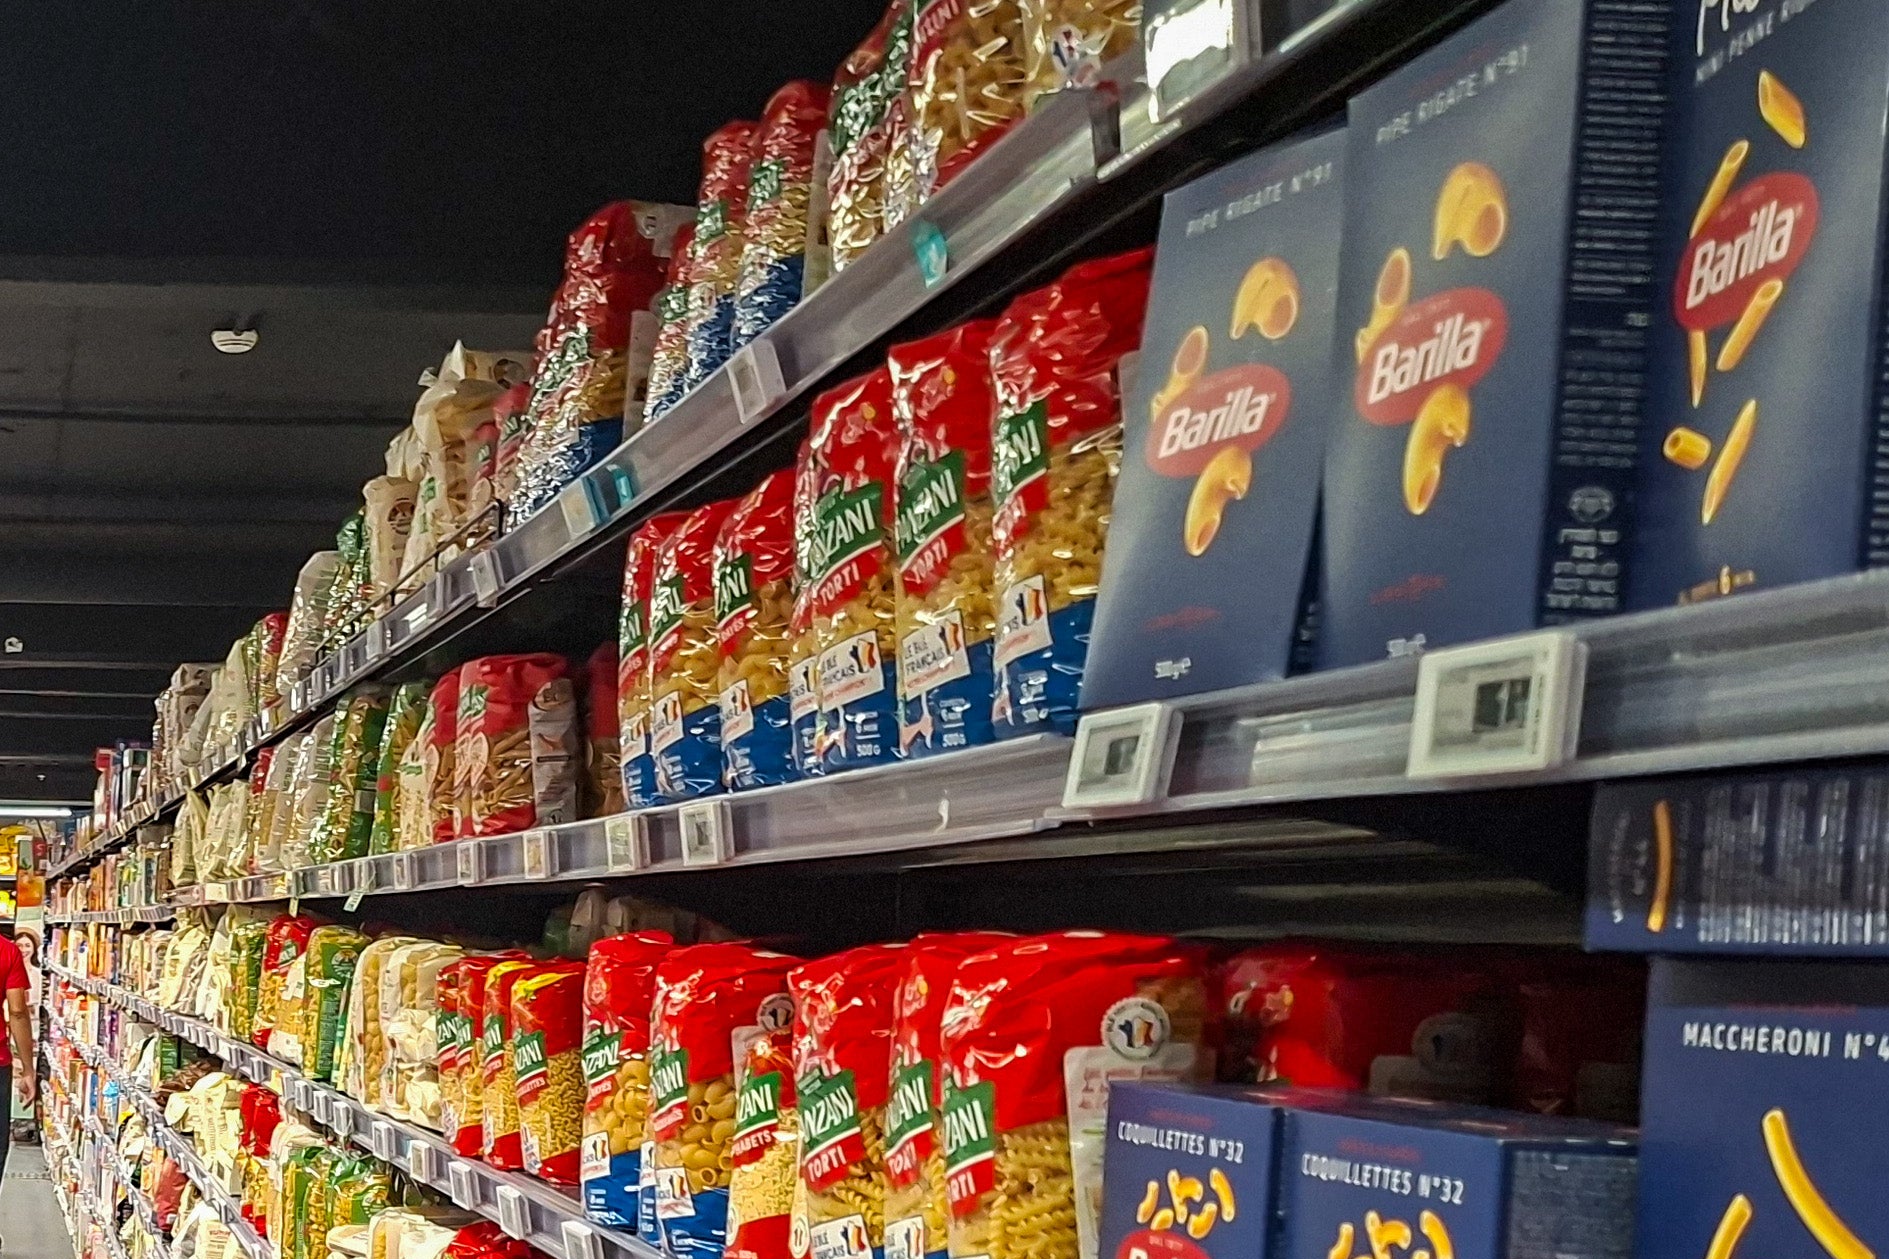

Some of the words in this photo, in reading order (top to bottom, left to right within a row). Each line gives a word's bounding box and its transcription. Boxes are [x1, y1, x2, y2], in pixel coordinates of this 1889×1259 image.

[1686, 200, 1796, 310] Barilla
[1368, 312, 1486, 405] Barilla
[1158, 386, 1272, 459] Barilla
[819, 562, 860, 605] TORTI
[1683, 1022, 1831, 1057] MACCHERONI
[808, 1145, 847, 1183] TORTI
[1117, 1121, 1205, 1156] COQUILLETTES
[1208, 1137, 1244, 1164] N°32
[1302, 1153, 1413, 1196] COQUILLETTES
[1418, 1174, 1464, 1205] N°32
